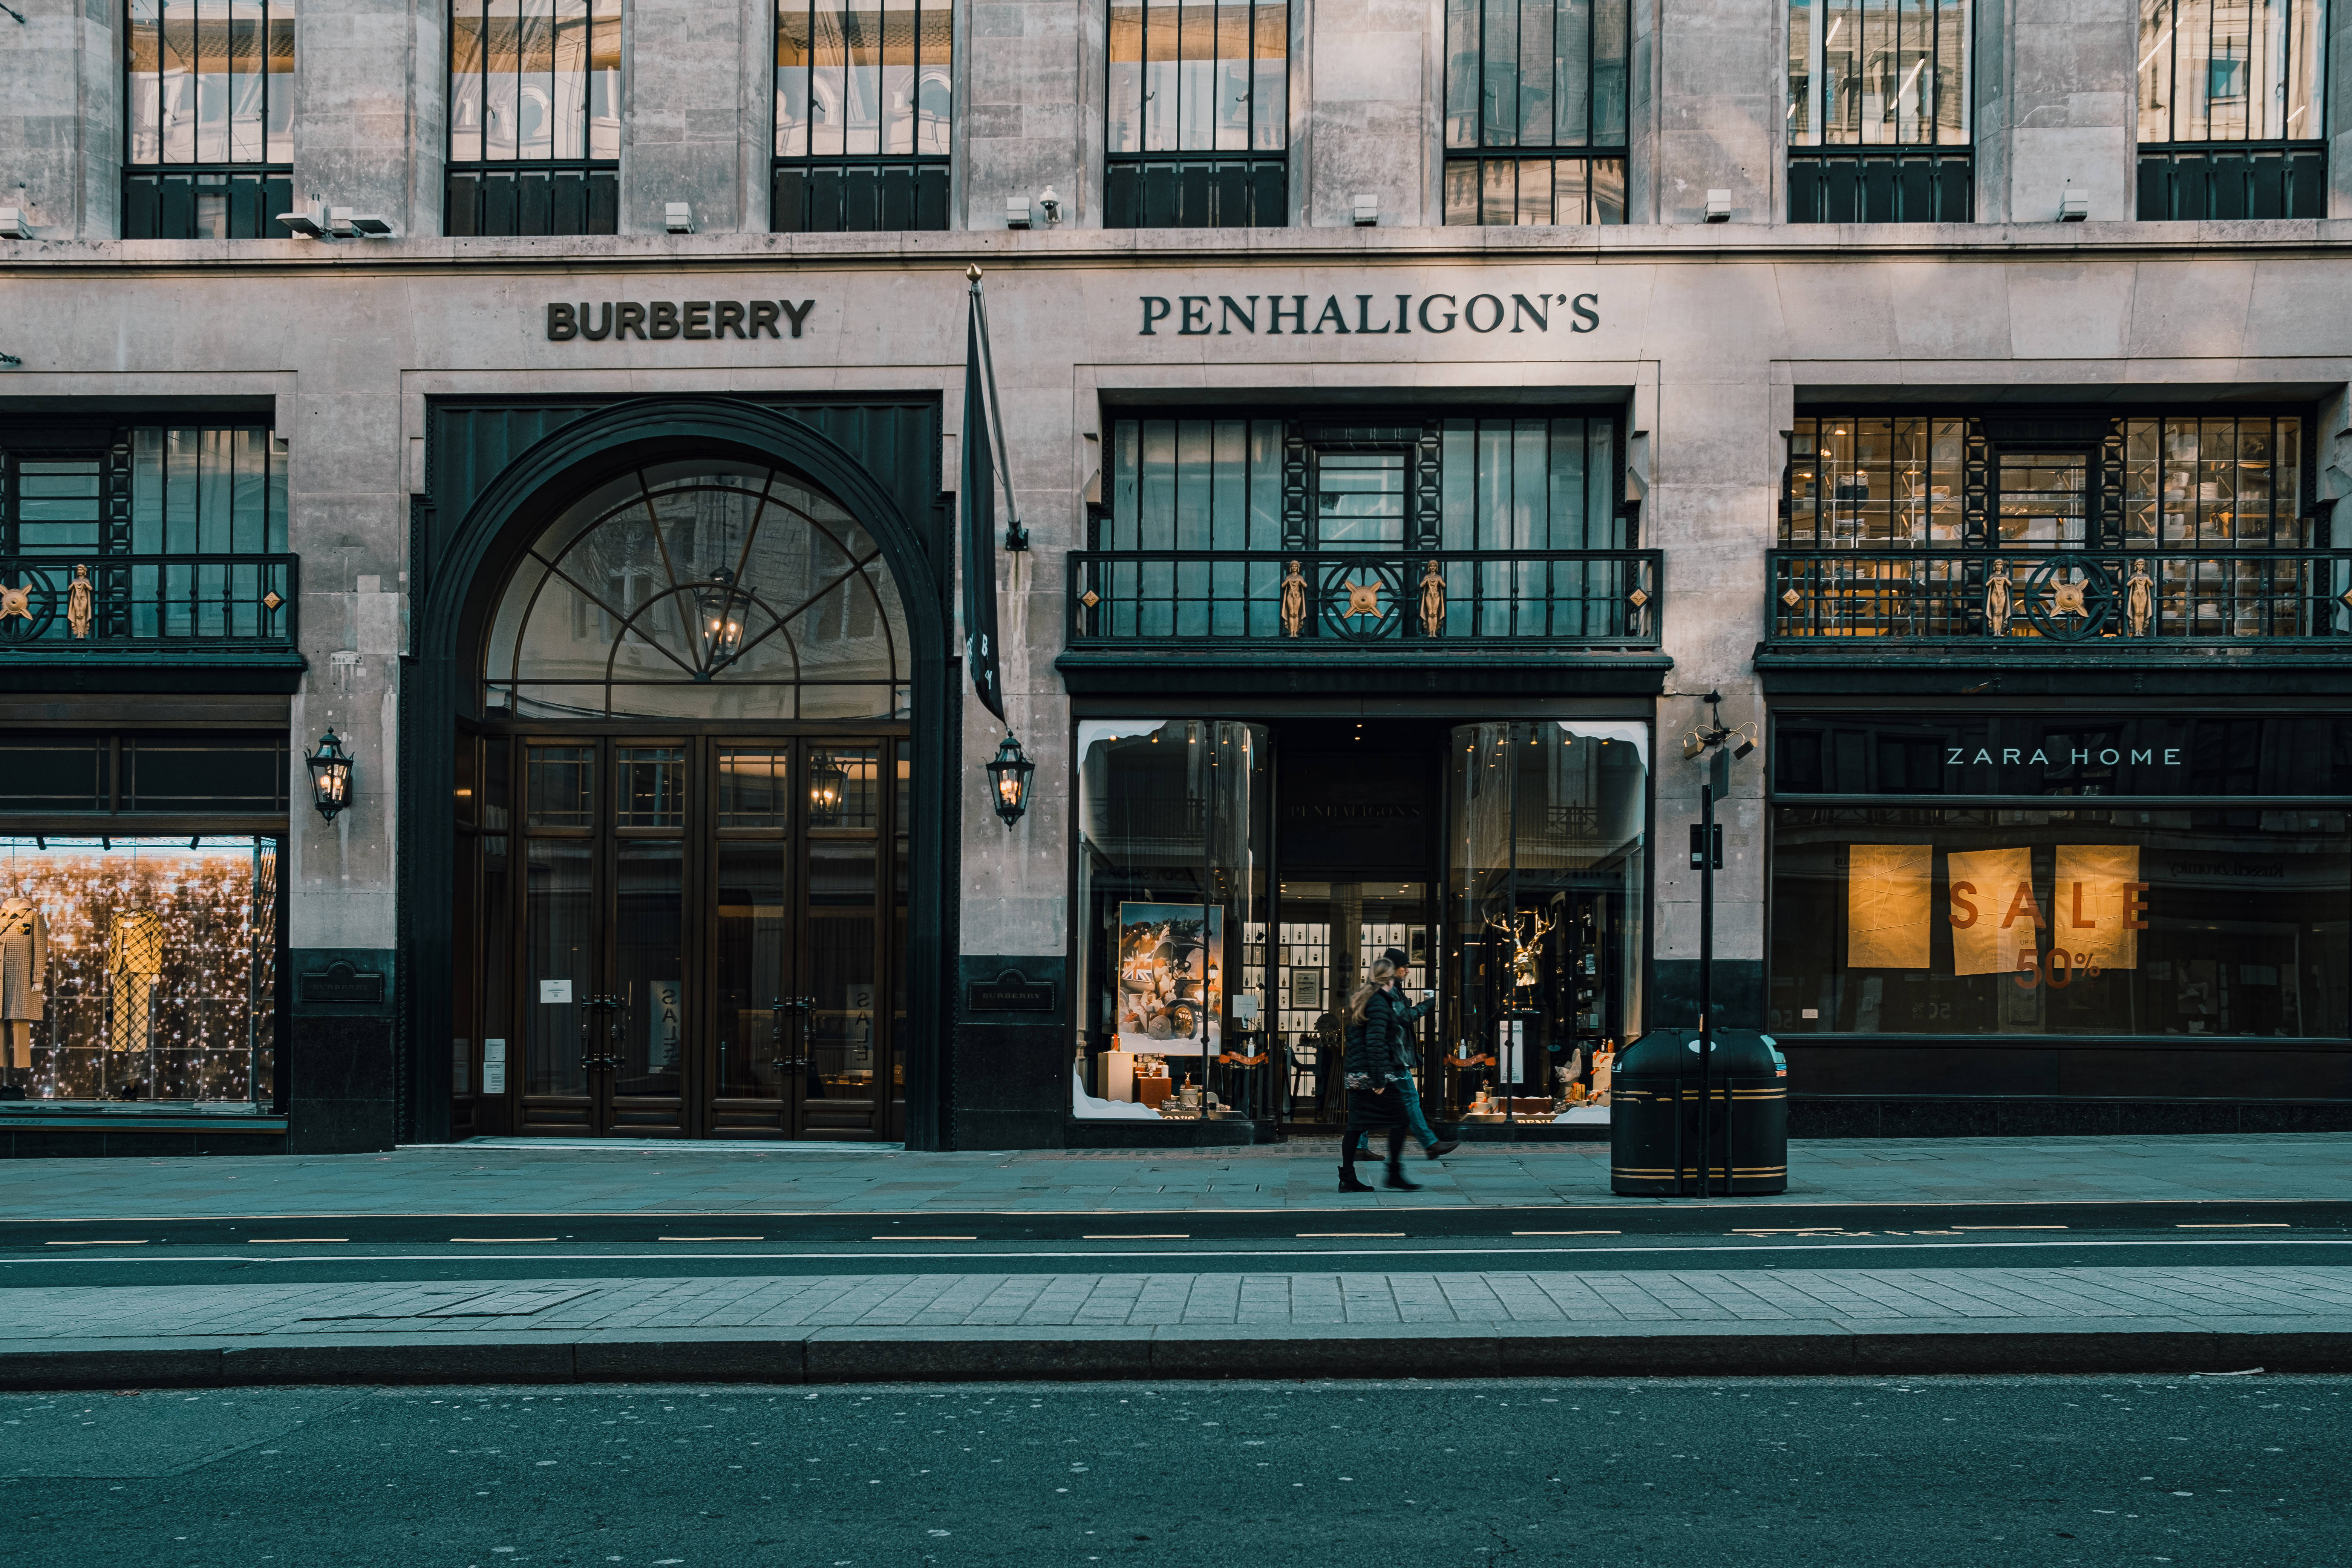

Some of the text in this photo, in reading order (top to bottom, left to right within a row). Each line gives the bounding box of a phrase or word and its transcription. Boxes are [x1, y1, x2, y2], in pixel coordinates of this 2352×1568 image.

[548, 300, 815, 340] BURBERRY
[1139, 293, 1600, 335] PENHALIGON'S
[1947, 748, 2181, 765] ZARA HOME
[1949, 881, 2149, 929] SALE
[2015, 948, 2101, 989] 50%
